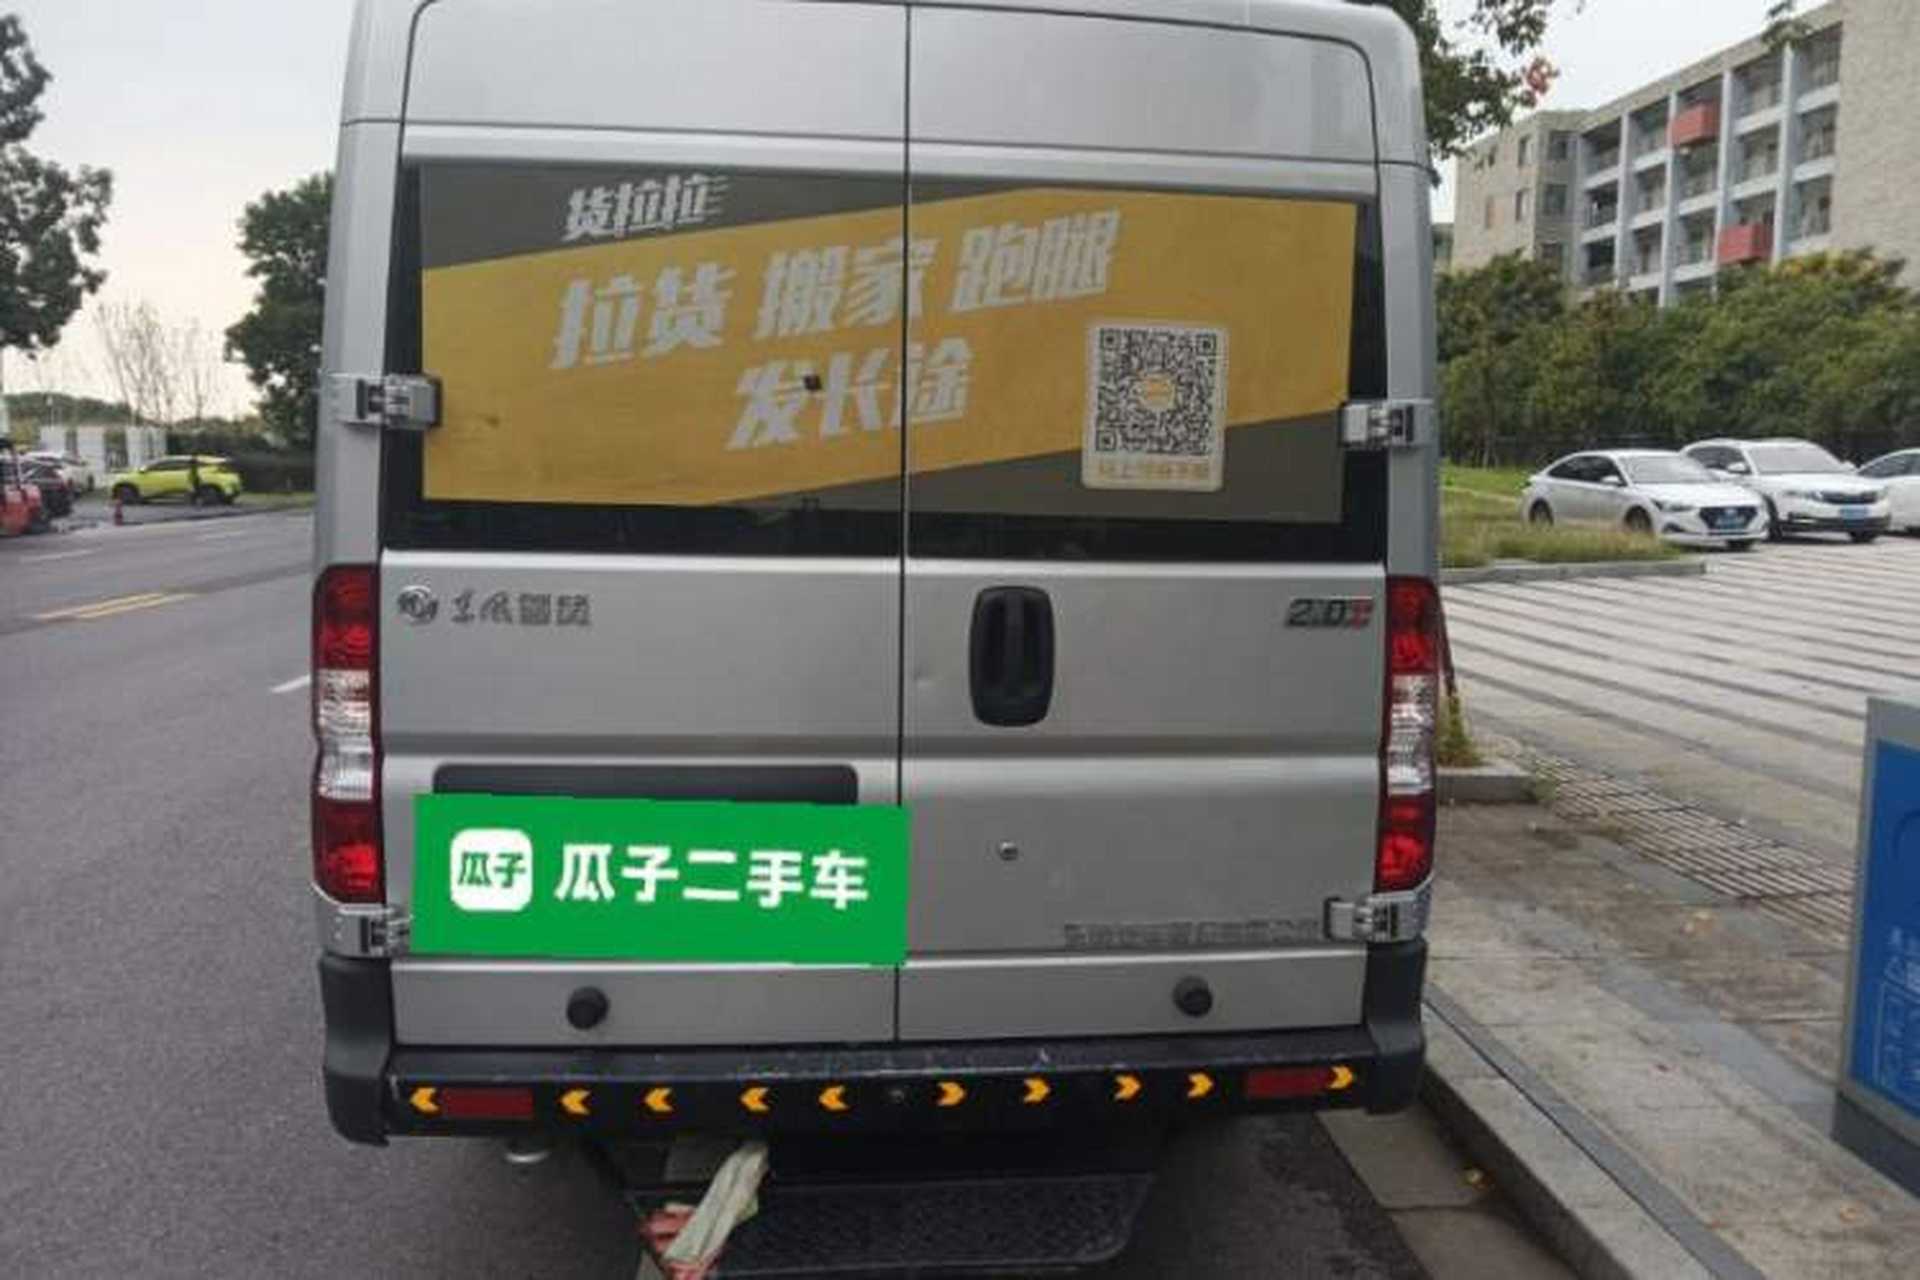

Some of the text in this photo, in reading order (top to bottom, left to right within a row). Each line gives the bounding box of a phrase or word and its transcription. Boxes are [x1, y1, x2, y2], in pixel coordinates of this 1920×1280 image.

[563, 175, 727, 240] 货拉拉
[551, 210, 1119, 369] 拉货 搬家 跑腿
[727, 337, 973, 449] 发长途
